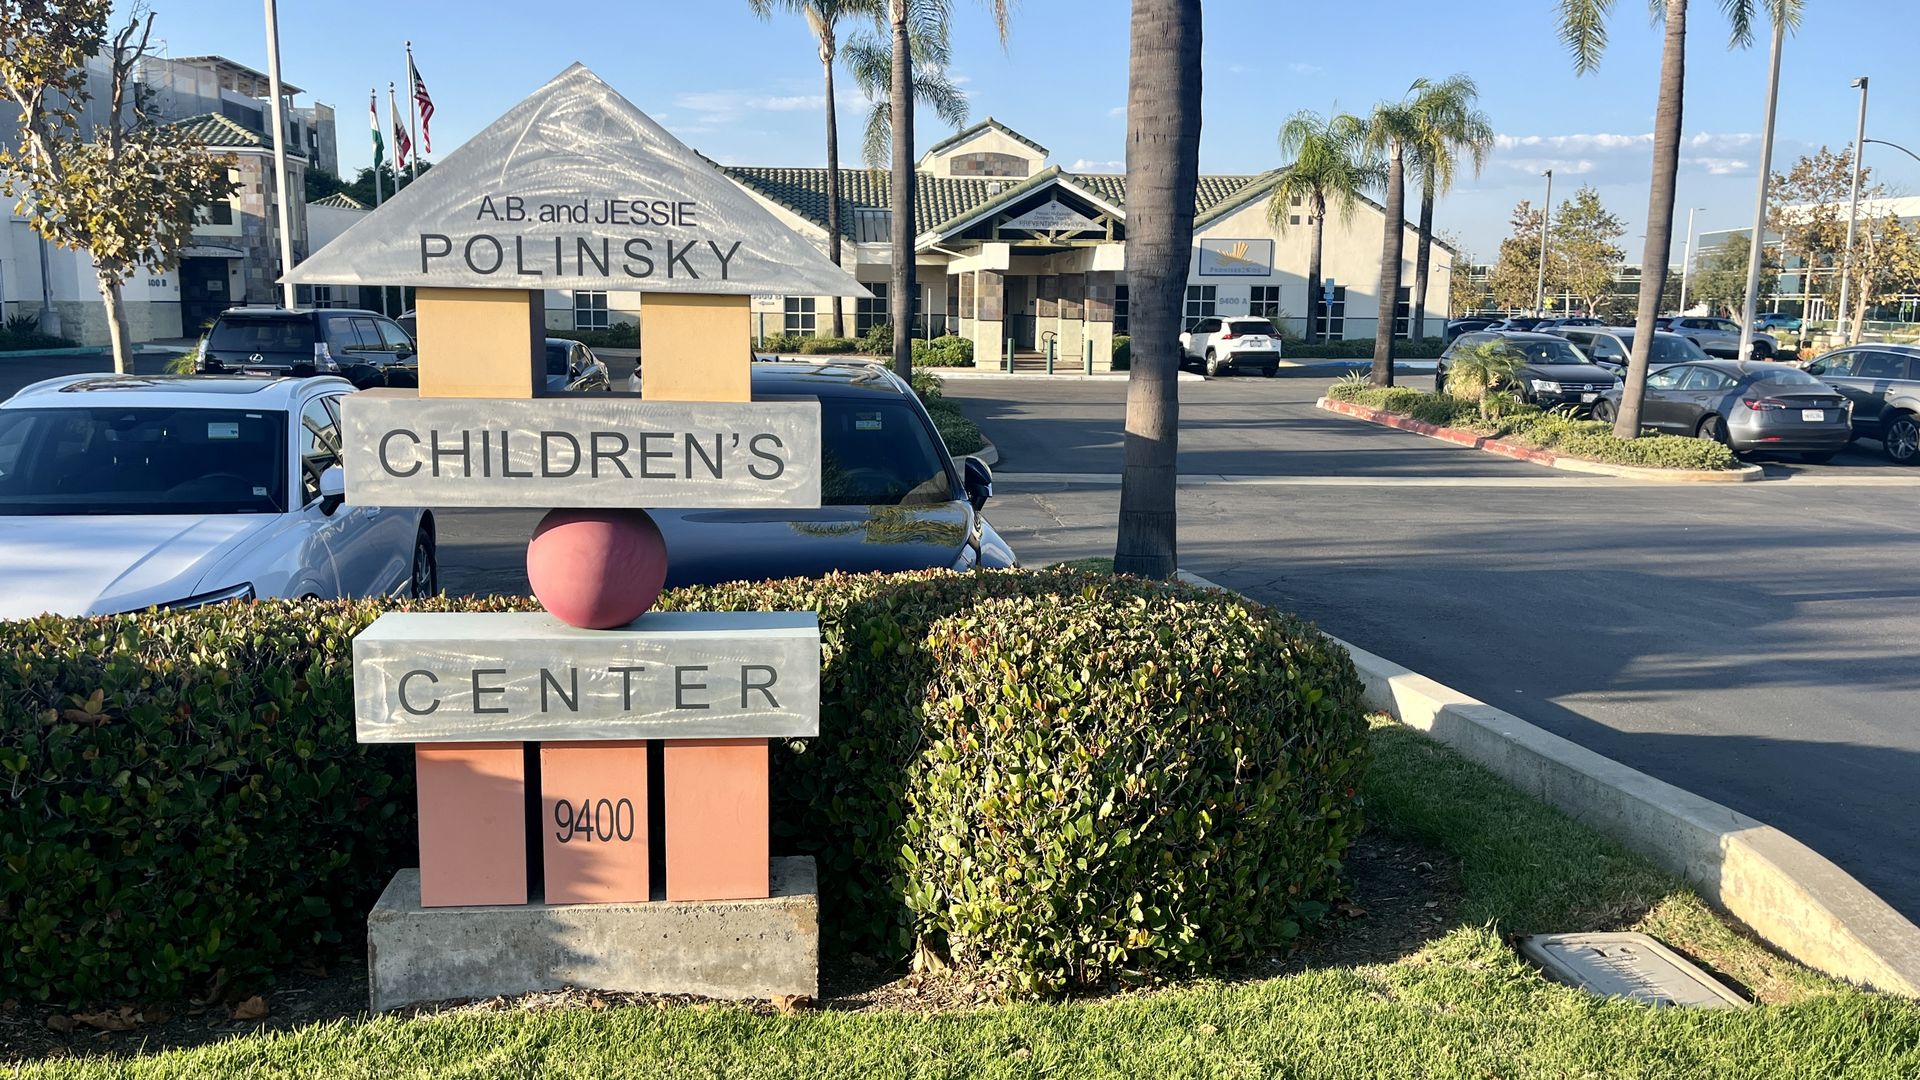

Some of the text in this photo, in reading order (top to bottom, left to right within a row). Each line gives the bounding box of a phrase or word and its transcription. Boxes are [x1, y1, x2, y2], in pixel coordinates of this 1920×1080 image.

[476, 195, 697, 227] A.B. and JESSIE
[420, 233, 742, 281] POLINSKY
[1219, 297, 1240, 305] 9400
[378, 428, 786, 481] CHILDREN’S
[398, 664, 780, 716] CENTER
[554, 797, 635, 844] 9400
